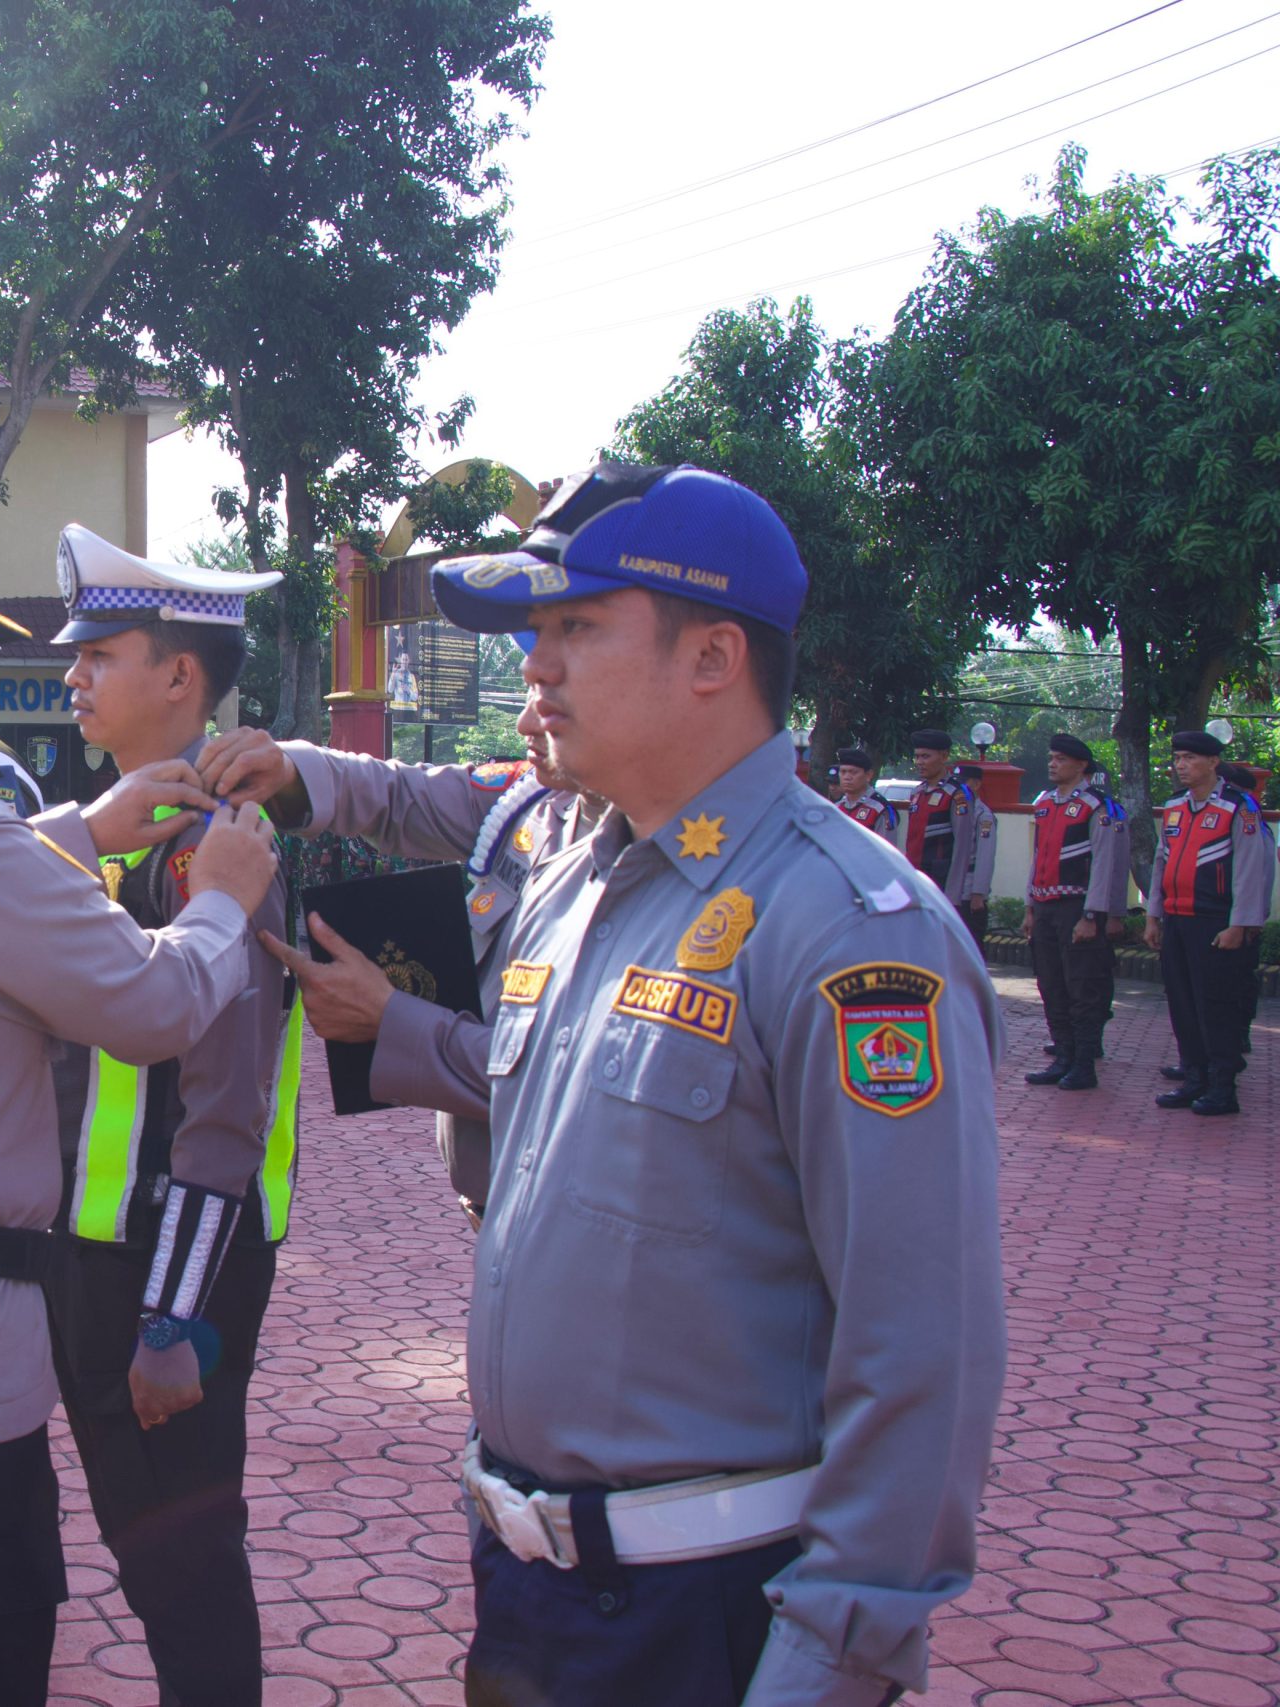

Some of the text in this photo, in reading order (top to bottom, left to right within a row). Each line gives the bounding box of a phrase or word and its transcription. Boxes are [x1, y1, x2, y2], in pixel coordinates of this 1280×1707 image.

[619, 553, 730, 593] KABUPATEN ASAHAN
[623, 976, 726, 1031] DISHUB
